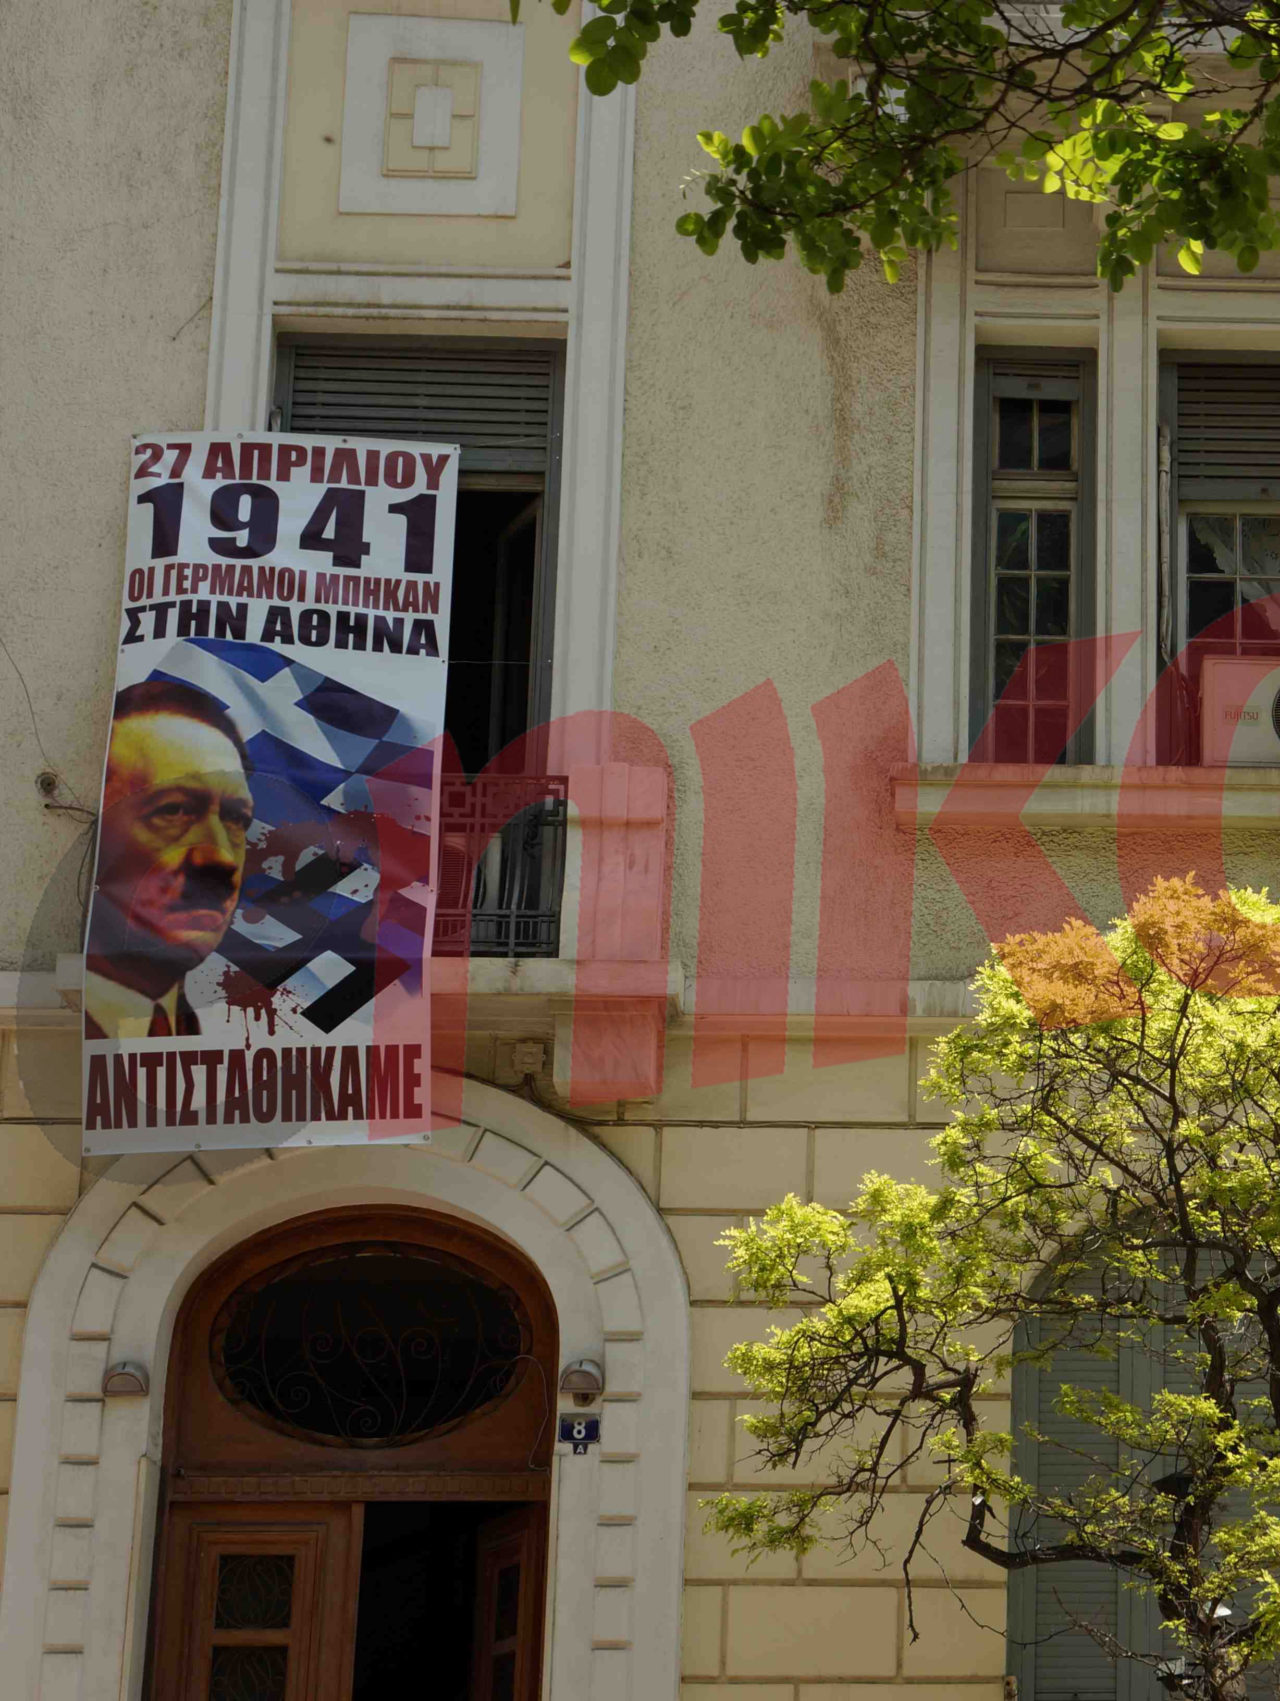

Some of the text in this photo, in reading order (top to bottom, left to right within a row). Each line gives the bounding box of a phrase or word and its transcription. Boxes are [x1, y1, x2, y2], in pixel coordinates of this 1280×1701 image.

[134, 442, 451, 491] 27 ΑΠΡΙΛΙΟΥ
[136, 482, 437, 575] 1941
[127, 562, 440, 615] ΟΙ ΓΕΡΜΑΝΟΙ ΜΠΗΚΑΝ
[121, 599, 440, 658] ΣΤΗΝ ΑΘΗΝΑ
[1224, 710, 1259, 721] FUJITSU
[84, 1043, 423, 1131] ΑΝΤΙΣΤΑΘΗΚΑΜΕ
[573, 1420, 586, 1439] 8
